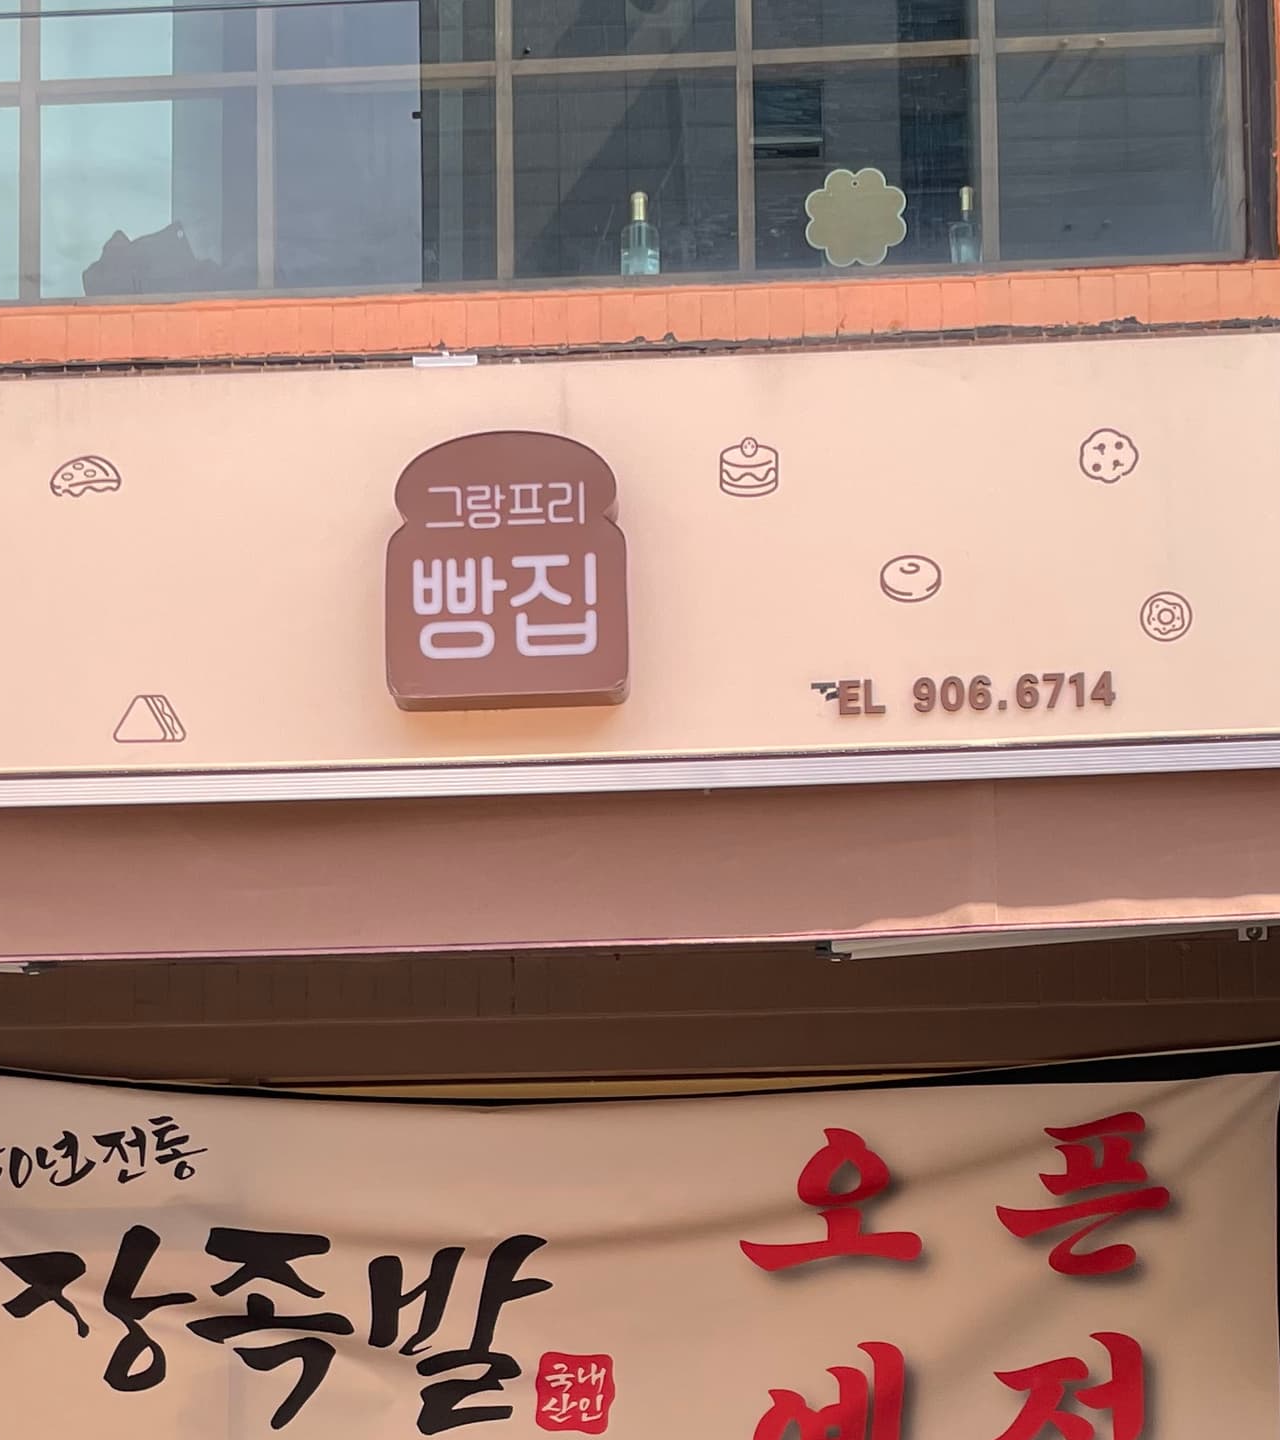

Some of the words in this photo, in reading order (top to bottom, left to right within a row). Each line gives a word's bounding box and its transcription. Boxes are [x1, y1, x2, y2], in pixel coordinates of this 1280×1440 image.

[425, 480, 587, 530] 그랑프리
[412, 551, 597, 661] 빵집
[912, 670, 1117, 713] 906.6714
[739, 1110, 1170, 1277] 오픈
